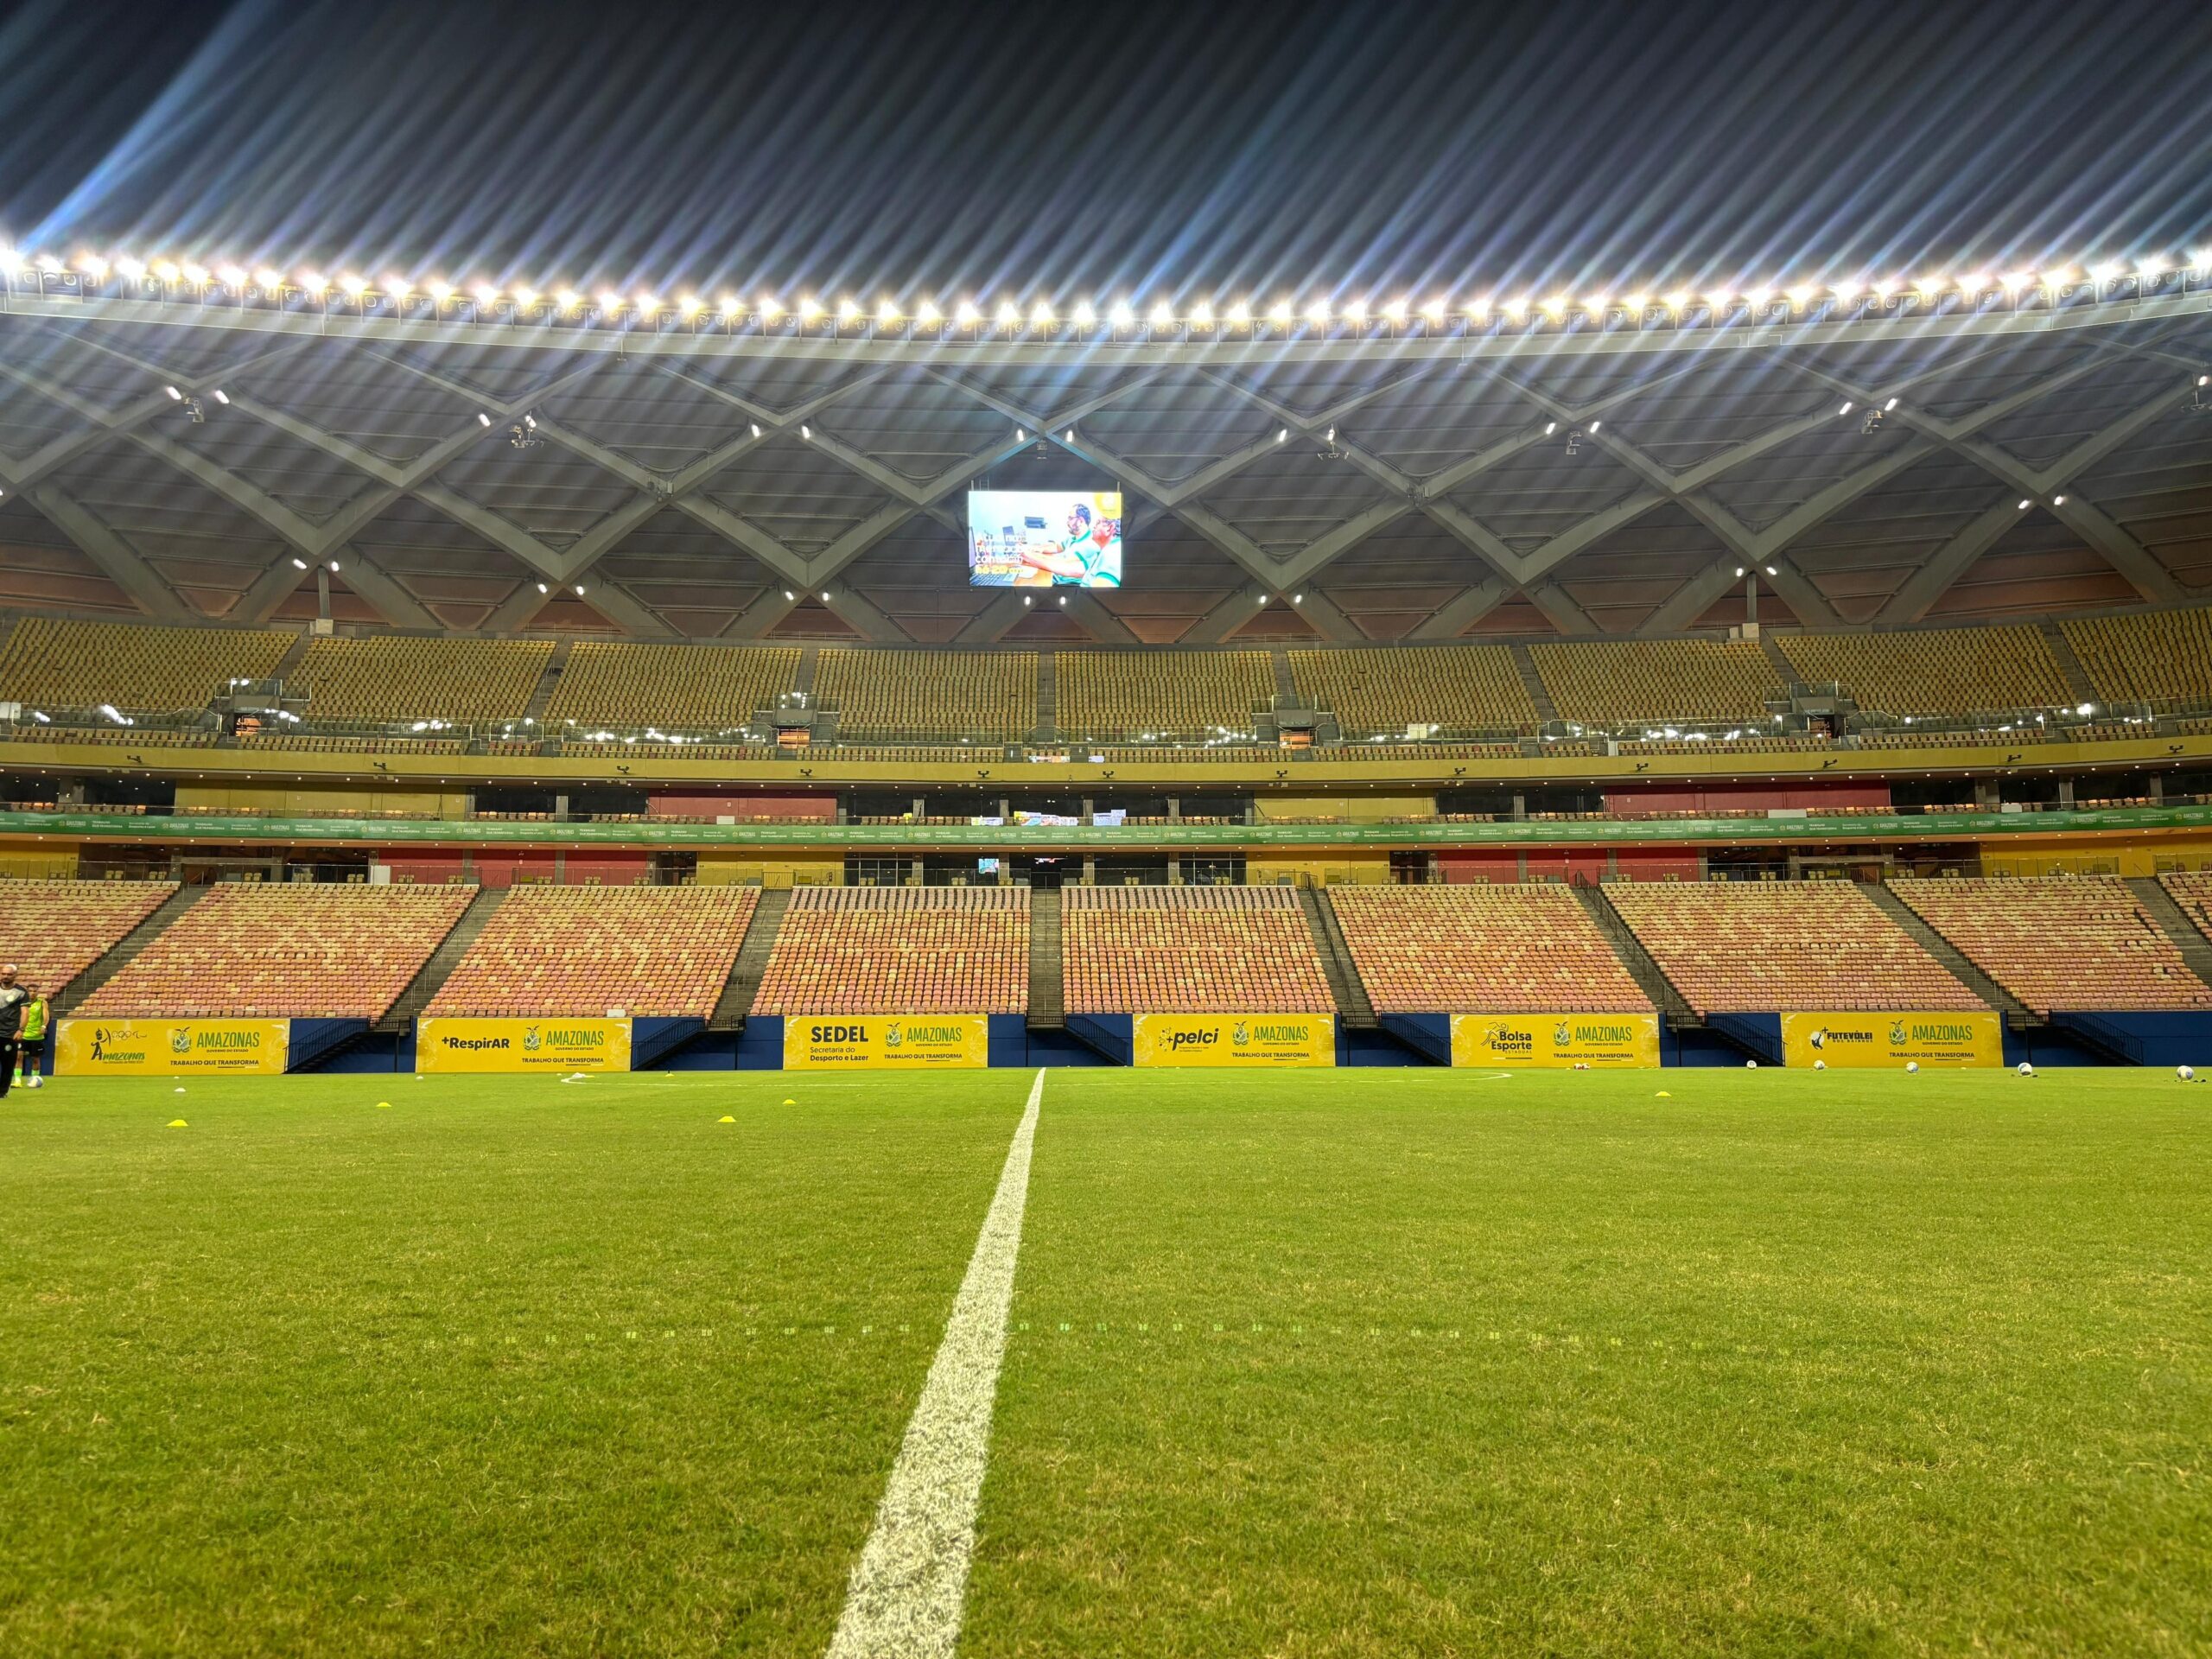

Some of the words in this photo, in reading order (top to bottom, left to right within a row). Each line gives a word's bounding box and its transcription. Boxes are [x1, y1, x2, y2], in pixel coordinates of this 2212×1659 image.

[197, 1031, 259, 1048] AMAZONAS
[546, 1030, 604, 1046] AMAZONAS
[810, 1026, 869, 1043] SEDEL
[907, 1027, 962, 1042] AMAZONAS
[1254, 1026, 1308, 1041] AMAZONAS
[1499, 1031, 1532, 1041] Bolsa
[1576, 1027, 1632, 1041] AMAZONAS
[1912, 1025, 1973, 1041] AMAZONAS
[91, 1044, 145, 1061] Amazonas
[1491, 1040, 1532, 1052] Esporte
